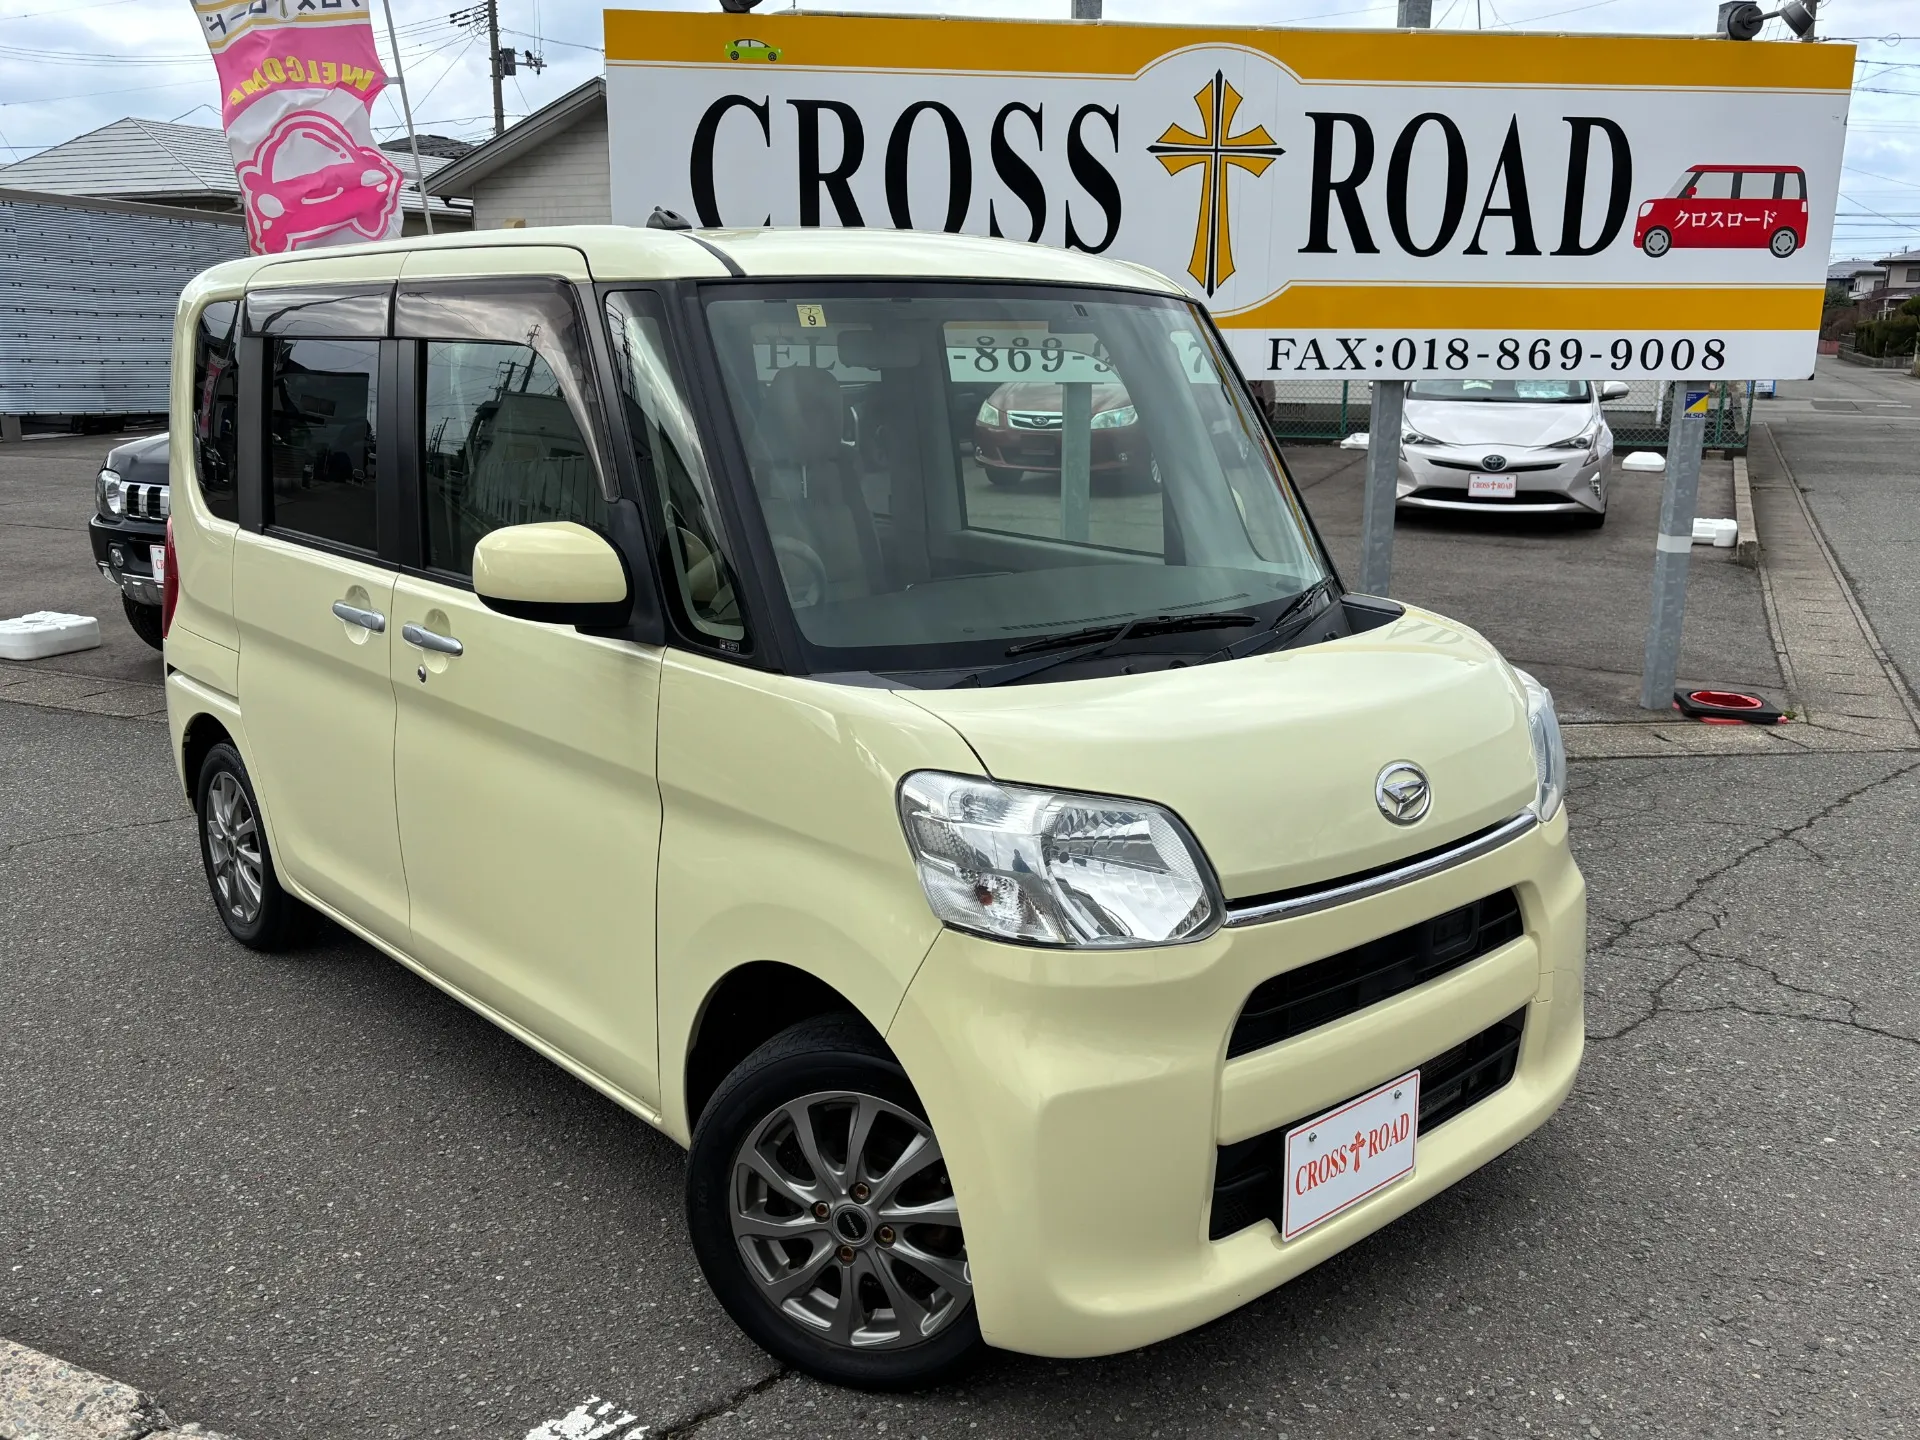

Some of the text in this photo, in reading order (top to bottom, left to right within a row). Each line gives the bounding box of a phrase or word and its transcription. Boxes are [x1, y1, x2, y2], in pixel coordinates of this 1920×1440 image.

[690, 94, 1633, 258] CROSS ROAD
[1673, 209, 1778, 230] クロスロード
[807, 315, 817, 326] 9
[1266, 337, 1727, 371] FAX:018-869-9008
[1496, 482, 1513, 490] ROAD
[1295, 1112, 1410, 1196] CROSS ROAD
